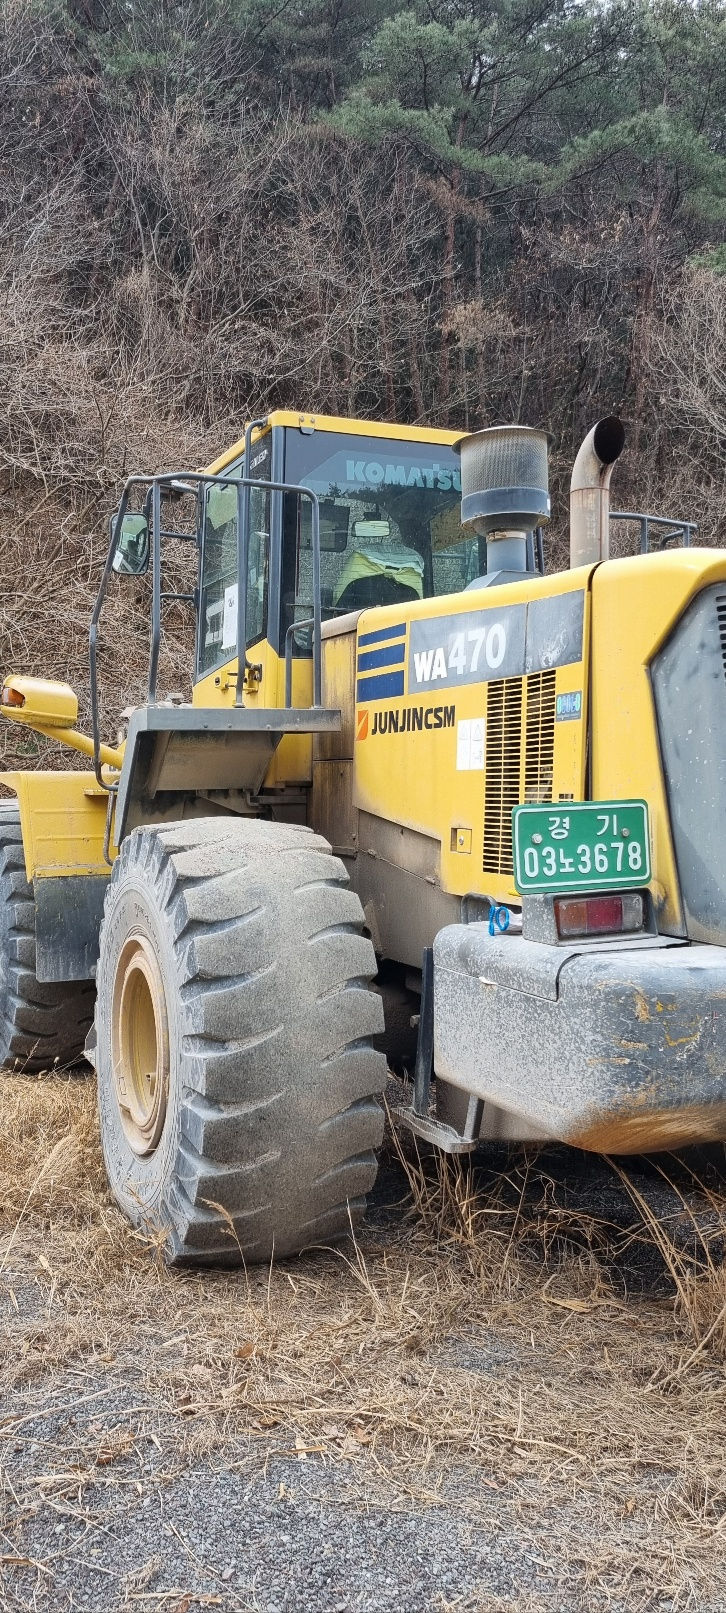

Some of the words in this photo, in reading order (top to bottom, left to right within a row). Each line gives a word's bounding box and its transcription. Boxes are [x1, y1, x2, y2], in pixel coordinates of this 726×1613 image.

[413, 623, 507, 683] WA470
[371, 704, 456, 736] JUNJINCSM
[523, 841, 642, 878] 03노3678
